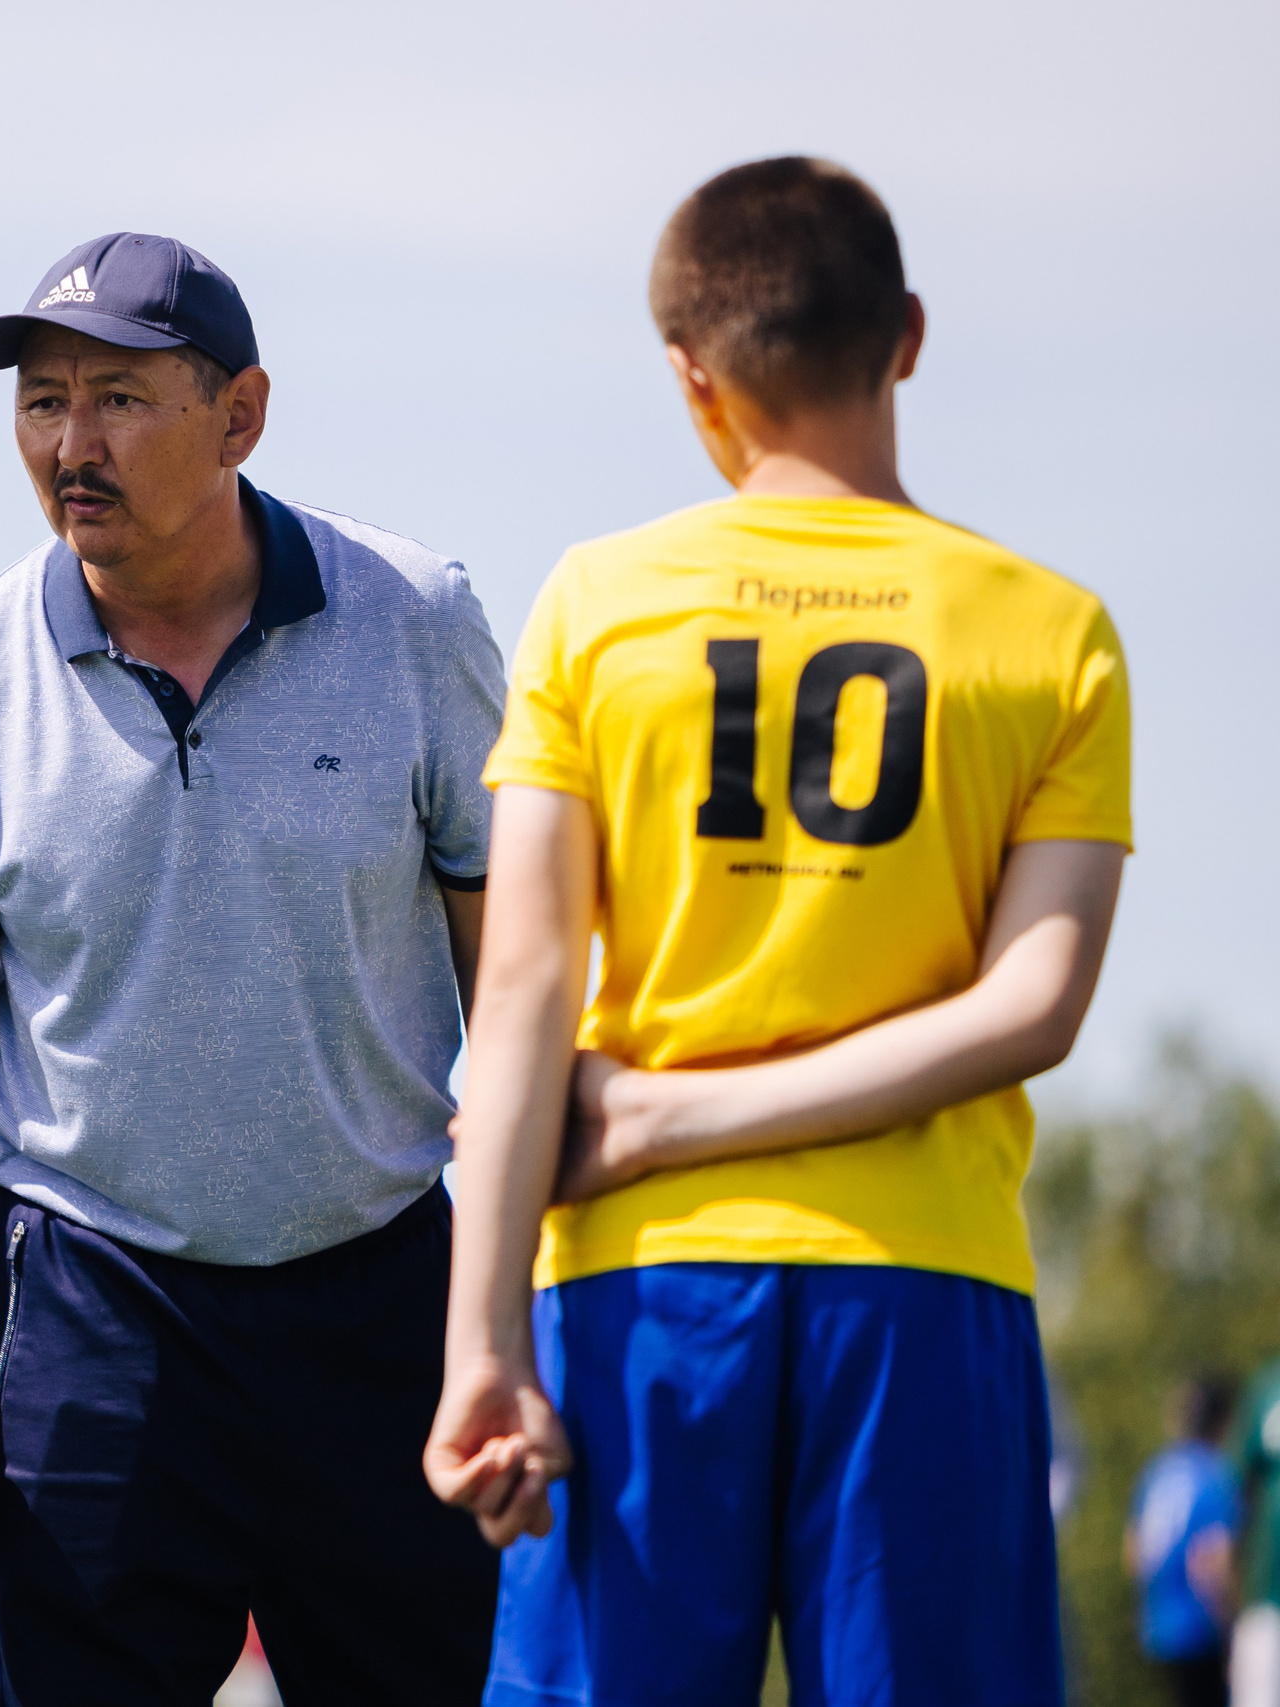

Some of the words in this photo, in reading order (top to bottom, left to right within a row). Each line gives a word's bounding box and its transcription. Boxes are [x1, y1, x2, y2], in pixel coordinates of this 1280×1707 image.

[38, 287, 96, 309] adidas
[736, 578, 911, 619] Первые
[696, 639, 928, 847] 10
[313, 754, 341, 773] CR
